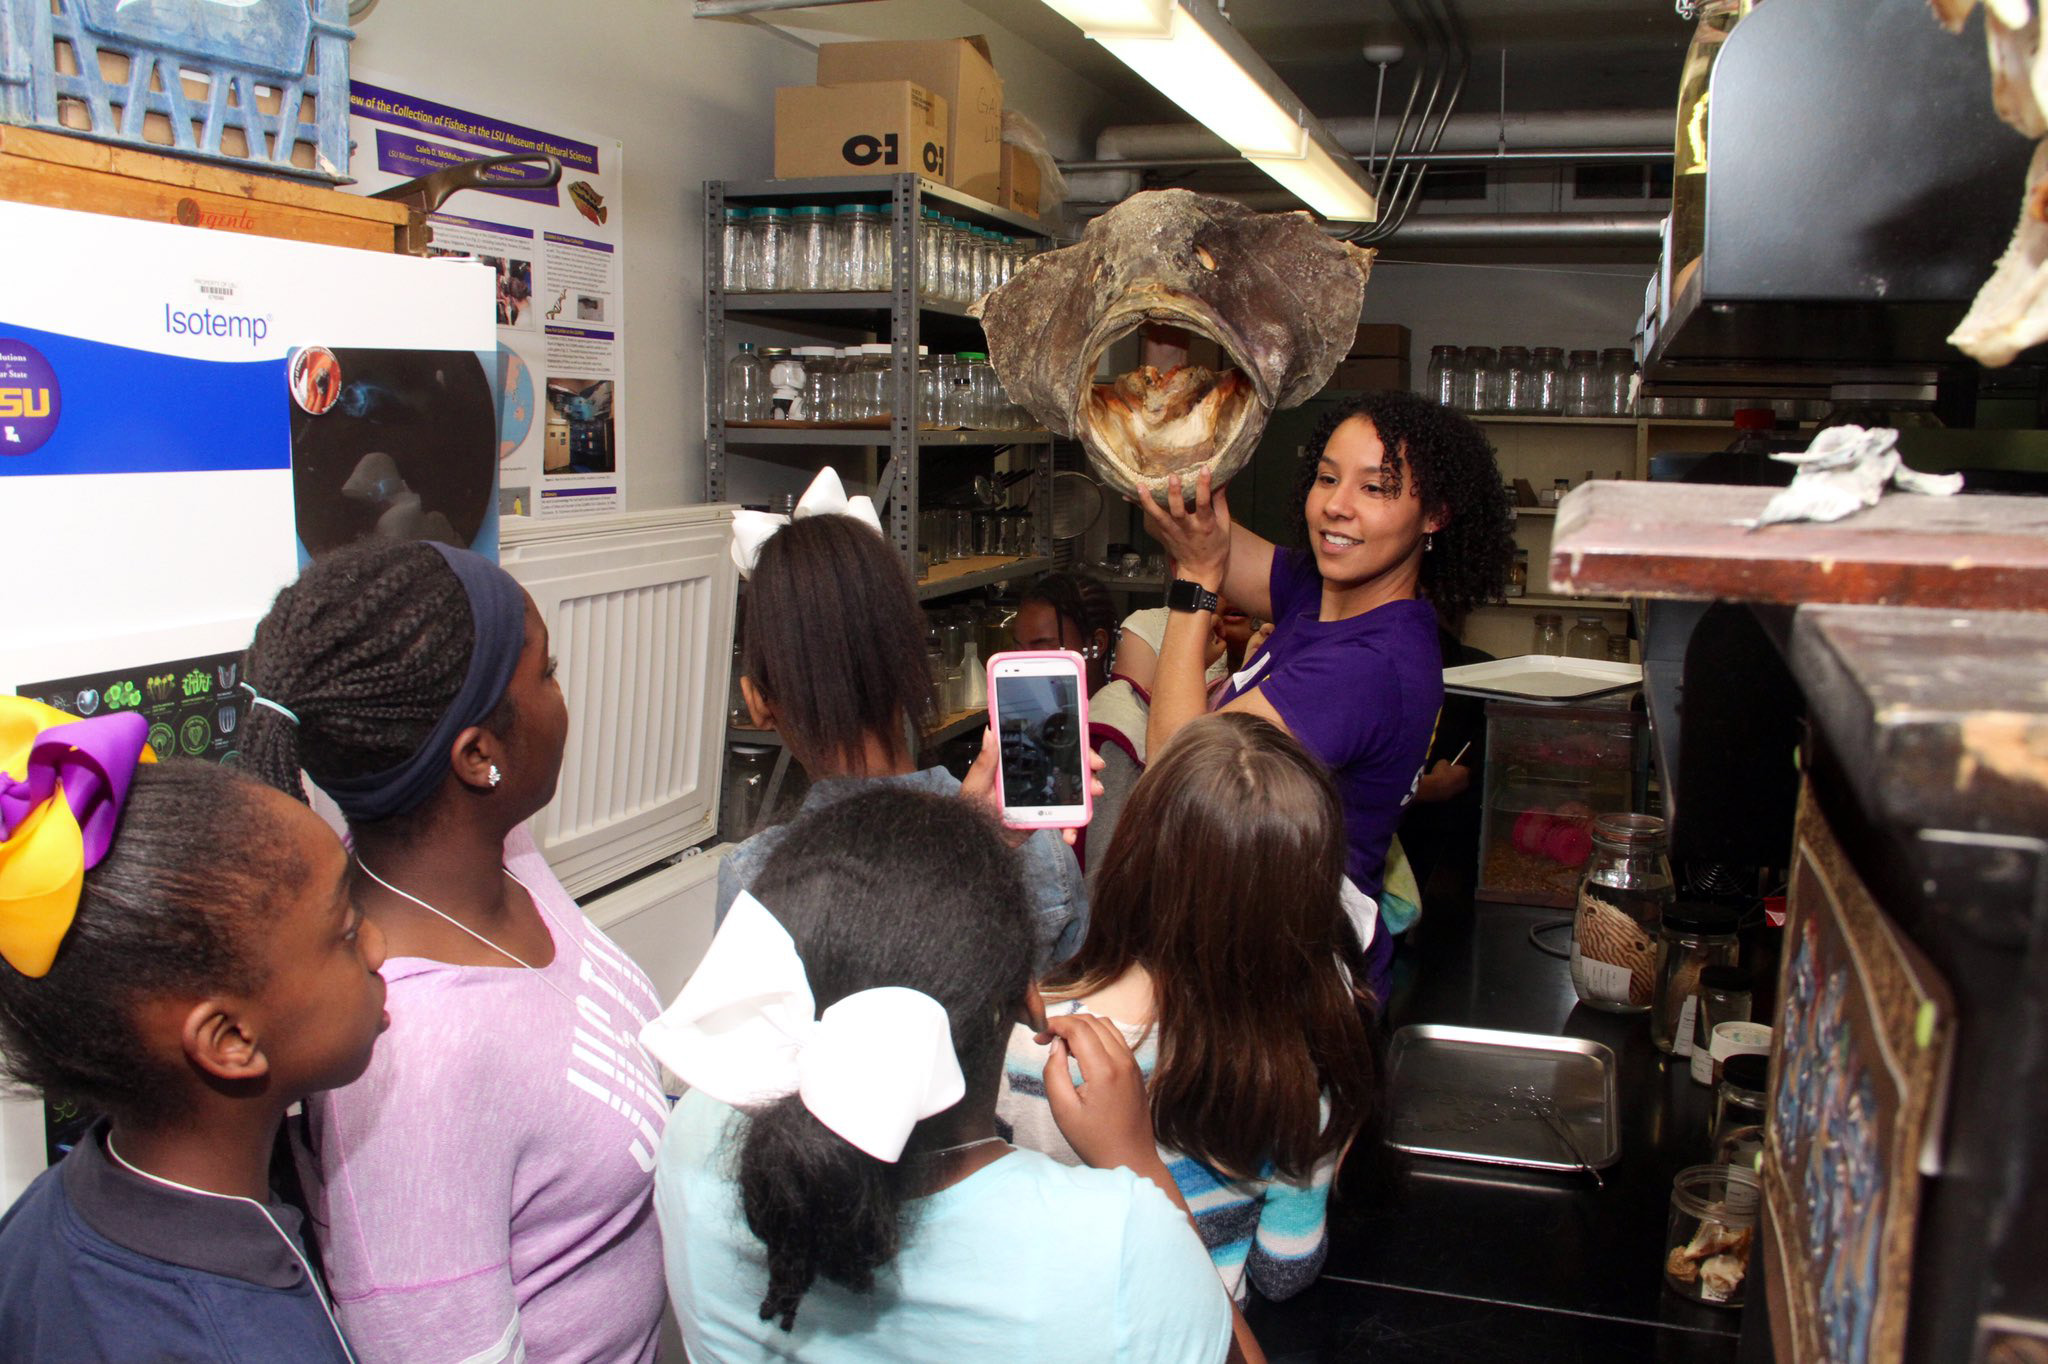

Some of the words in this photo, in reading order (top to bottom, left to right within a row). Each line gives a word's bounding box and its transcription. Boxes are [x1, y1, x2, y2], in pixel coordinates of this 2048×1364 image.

[350, 95, 364, 106] ew
[366, 97, 376, 108] of
[377, 99, 391, 113] the
[393, 103, 433, 122] Collection
[434, 114, 444, 125] of
[445, 117, 467, 133] Fishes
[468, 125, 477, 134] at
[478, 126, 490, 139] the
[491, 129, 505, 142] LSU
[506, 133, 535, 150] Museum
[536, 142, 544, 151] of
[545, 143, 569, 158] Natural
[569, 150, 593, 164] Science
[0, 352, 27, 362] lutions
[9, 369, 28, 379] State
[0, 387, 51, 418] SU
